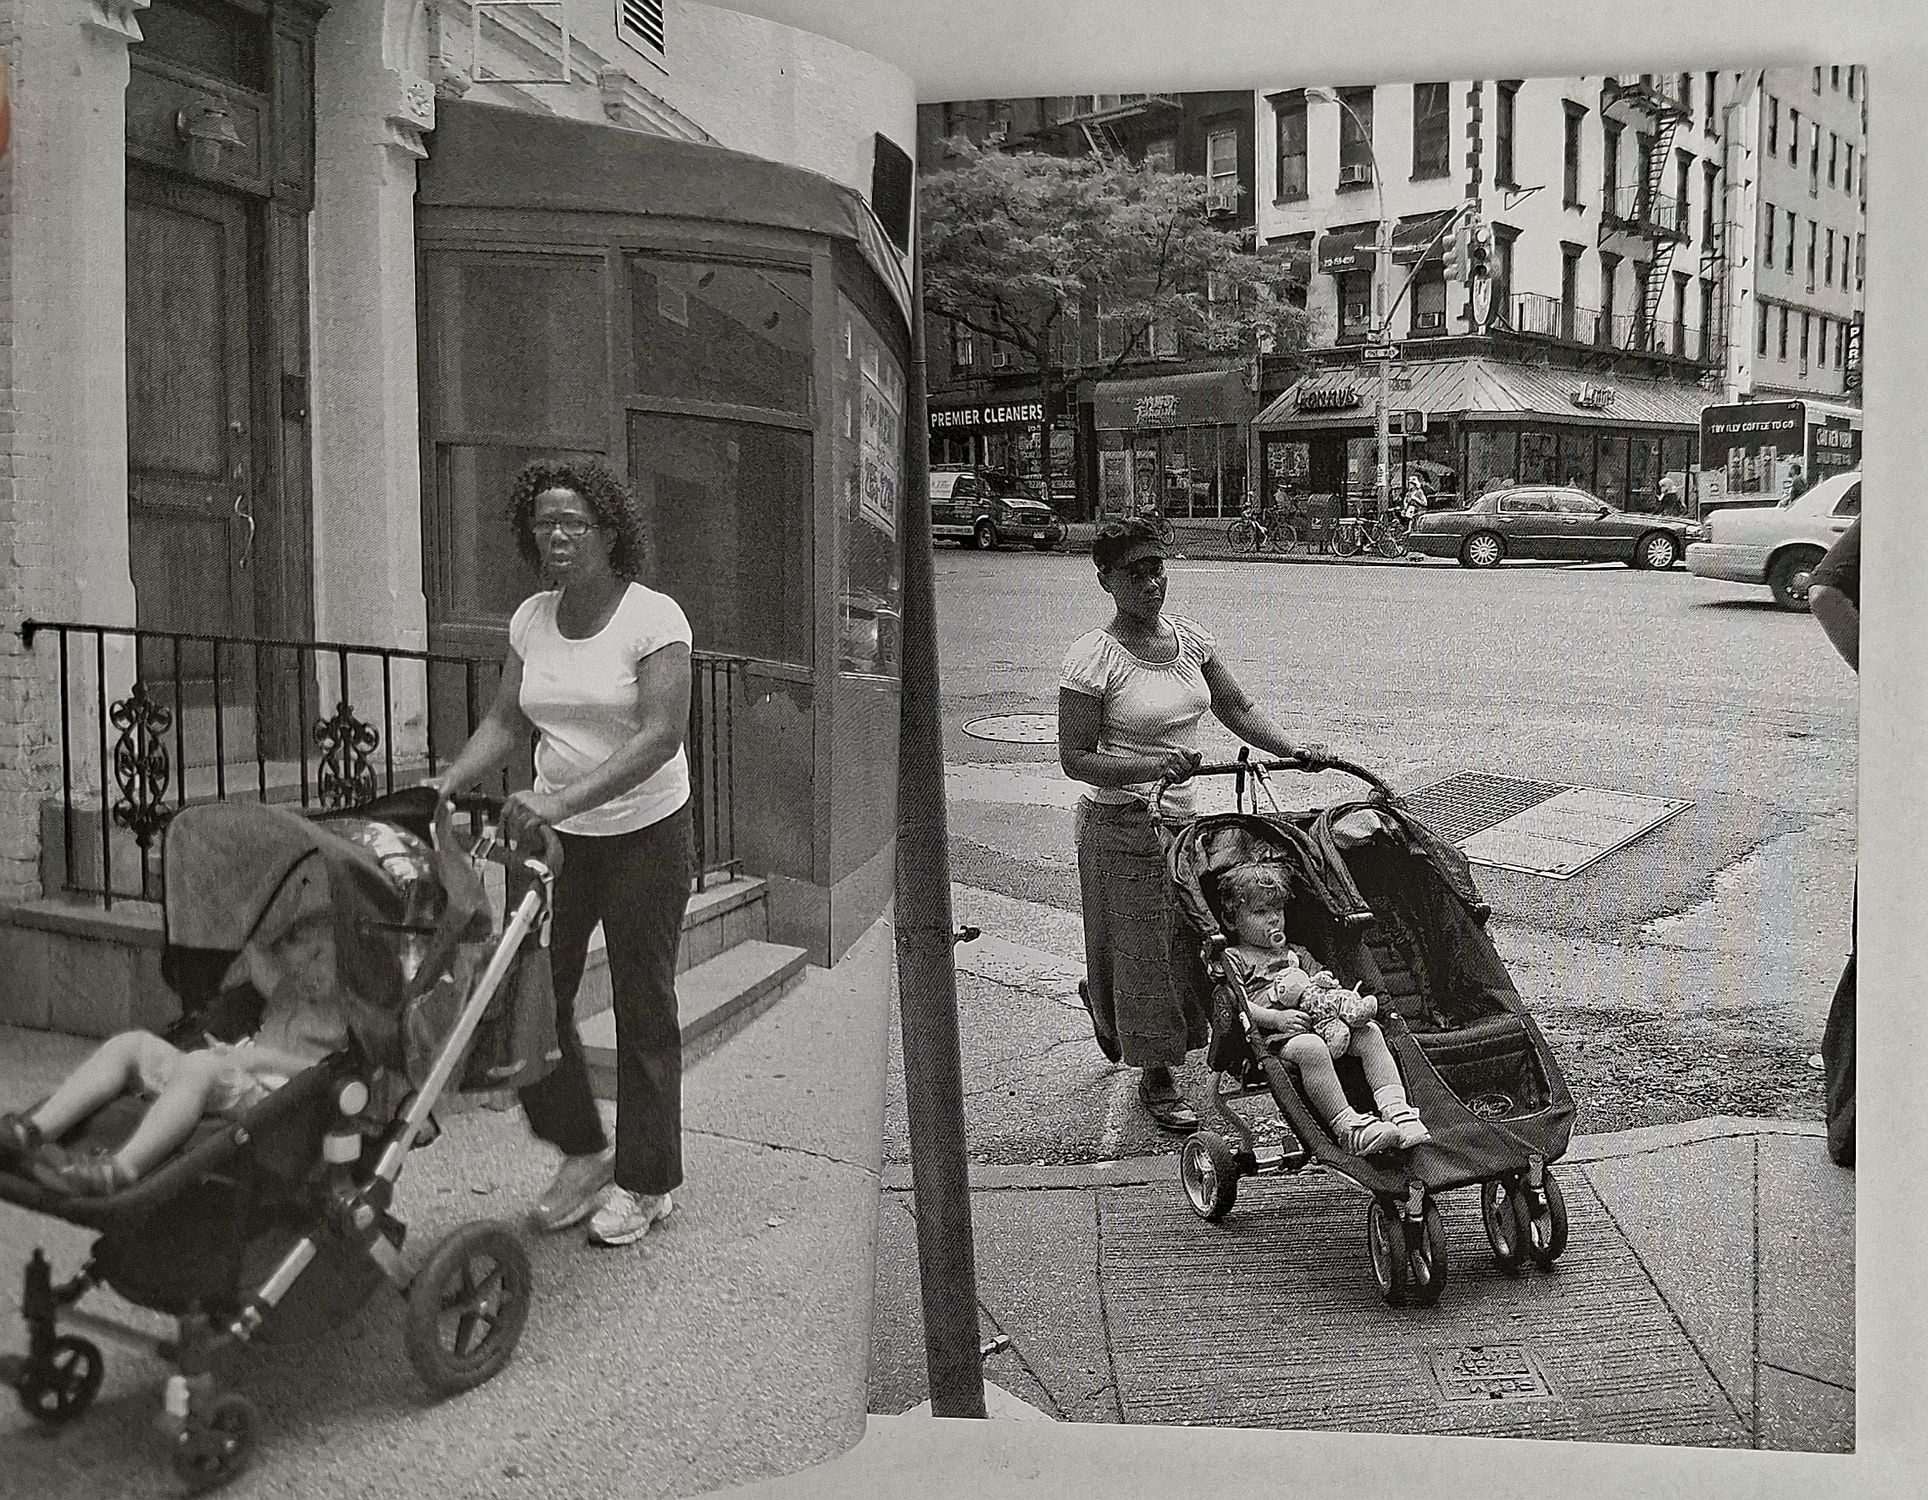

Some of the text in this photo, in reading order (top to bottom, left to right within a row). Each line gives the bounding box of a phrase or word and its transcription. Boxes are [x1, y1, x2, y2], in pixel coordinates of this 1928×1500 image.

[931, 404, 1043, 428] PREMIER CLEANERS
[1771, 420, 1782, 430] TO
[1783, 420, 1794, 429] GO
